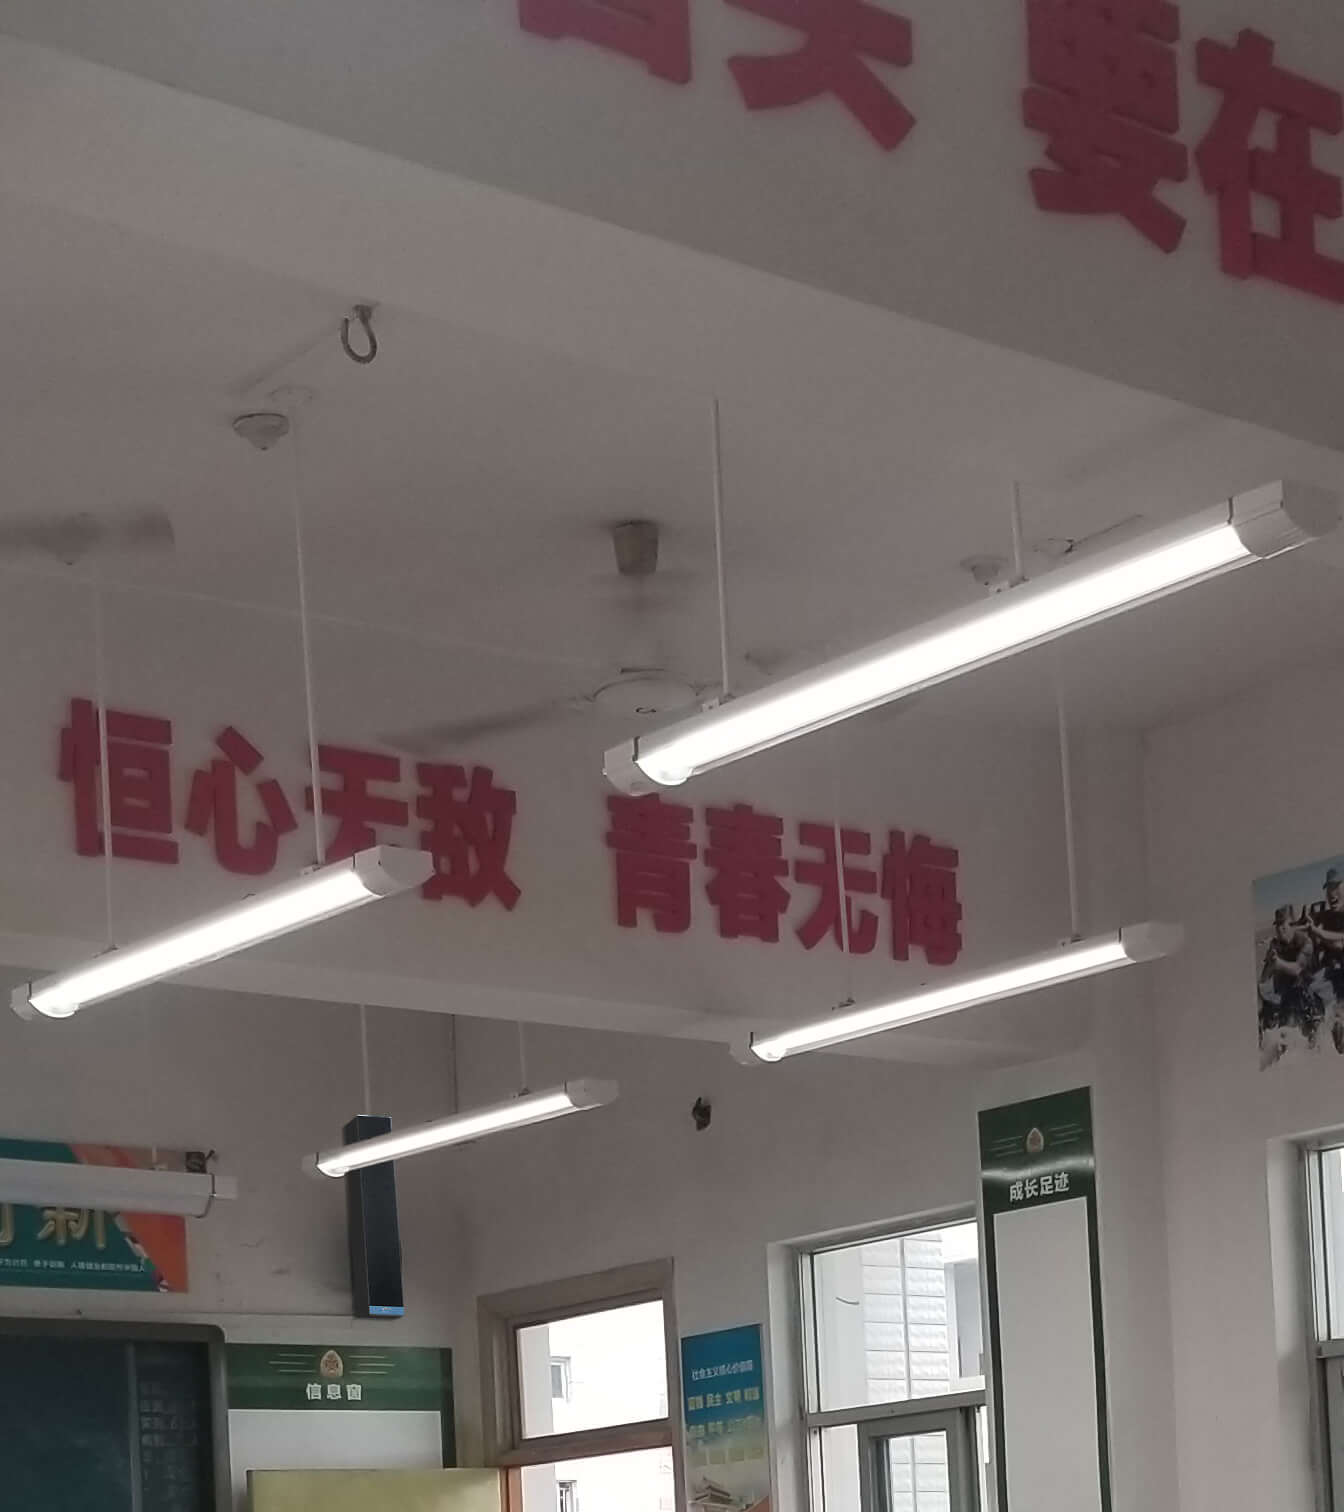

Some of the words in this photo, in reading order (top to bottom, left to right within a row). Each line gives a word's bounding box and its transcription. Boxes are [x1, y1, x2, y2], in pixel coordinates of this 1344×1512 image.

[58, 697, 522, 912] 恒心无敌
[604, 793, 964, 967] 青春无悔
[1009, 1172, 1070, 1202] 成长足迹
[306, 1383, 362, 1400] 信息窗
